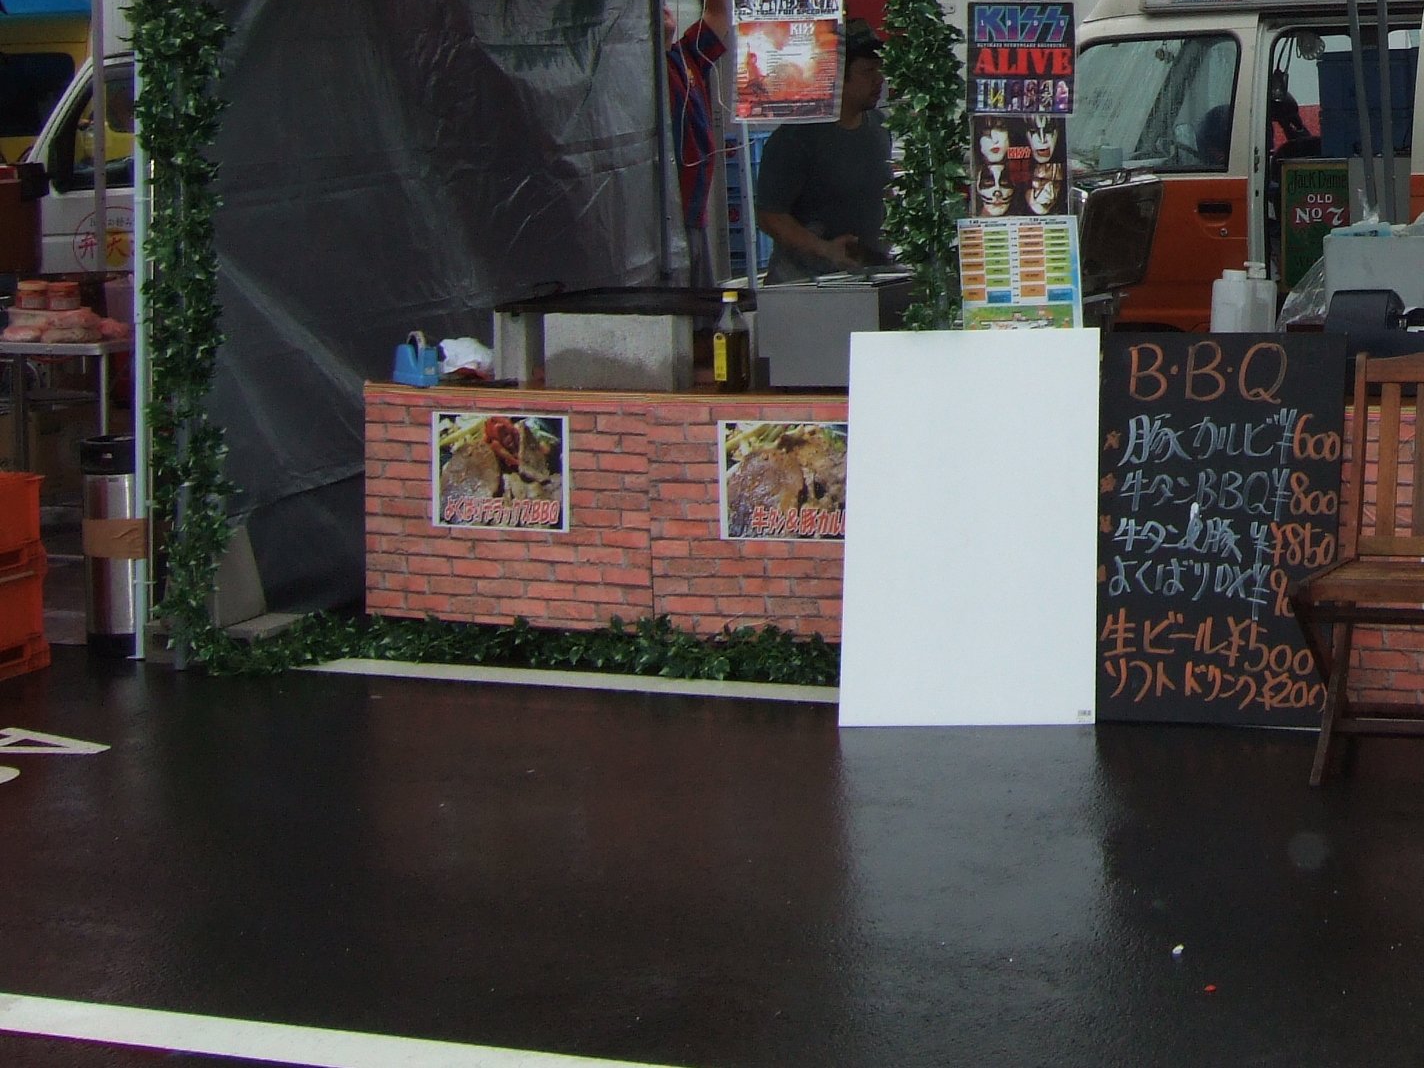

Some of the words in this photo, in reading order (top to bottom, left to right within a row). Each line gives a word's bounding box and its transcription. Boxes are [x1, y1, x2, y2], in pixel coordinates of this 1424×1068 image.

[975, 6, 1069, 43] KISS
[974, 48, 1072, 75] ALIVE
[1307, 193, 1332, 203] OLD
[1327, 207, 1344, 225] 7
